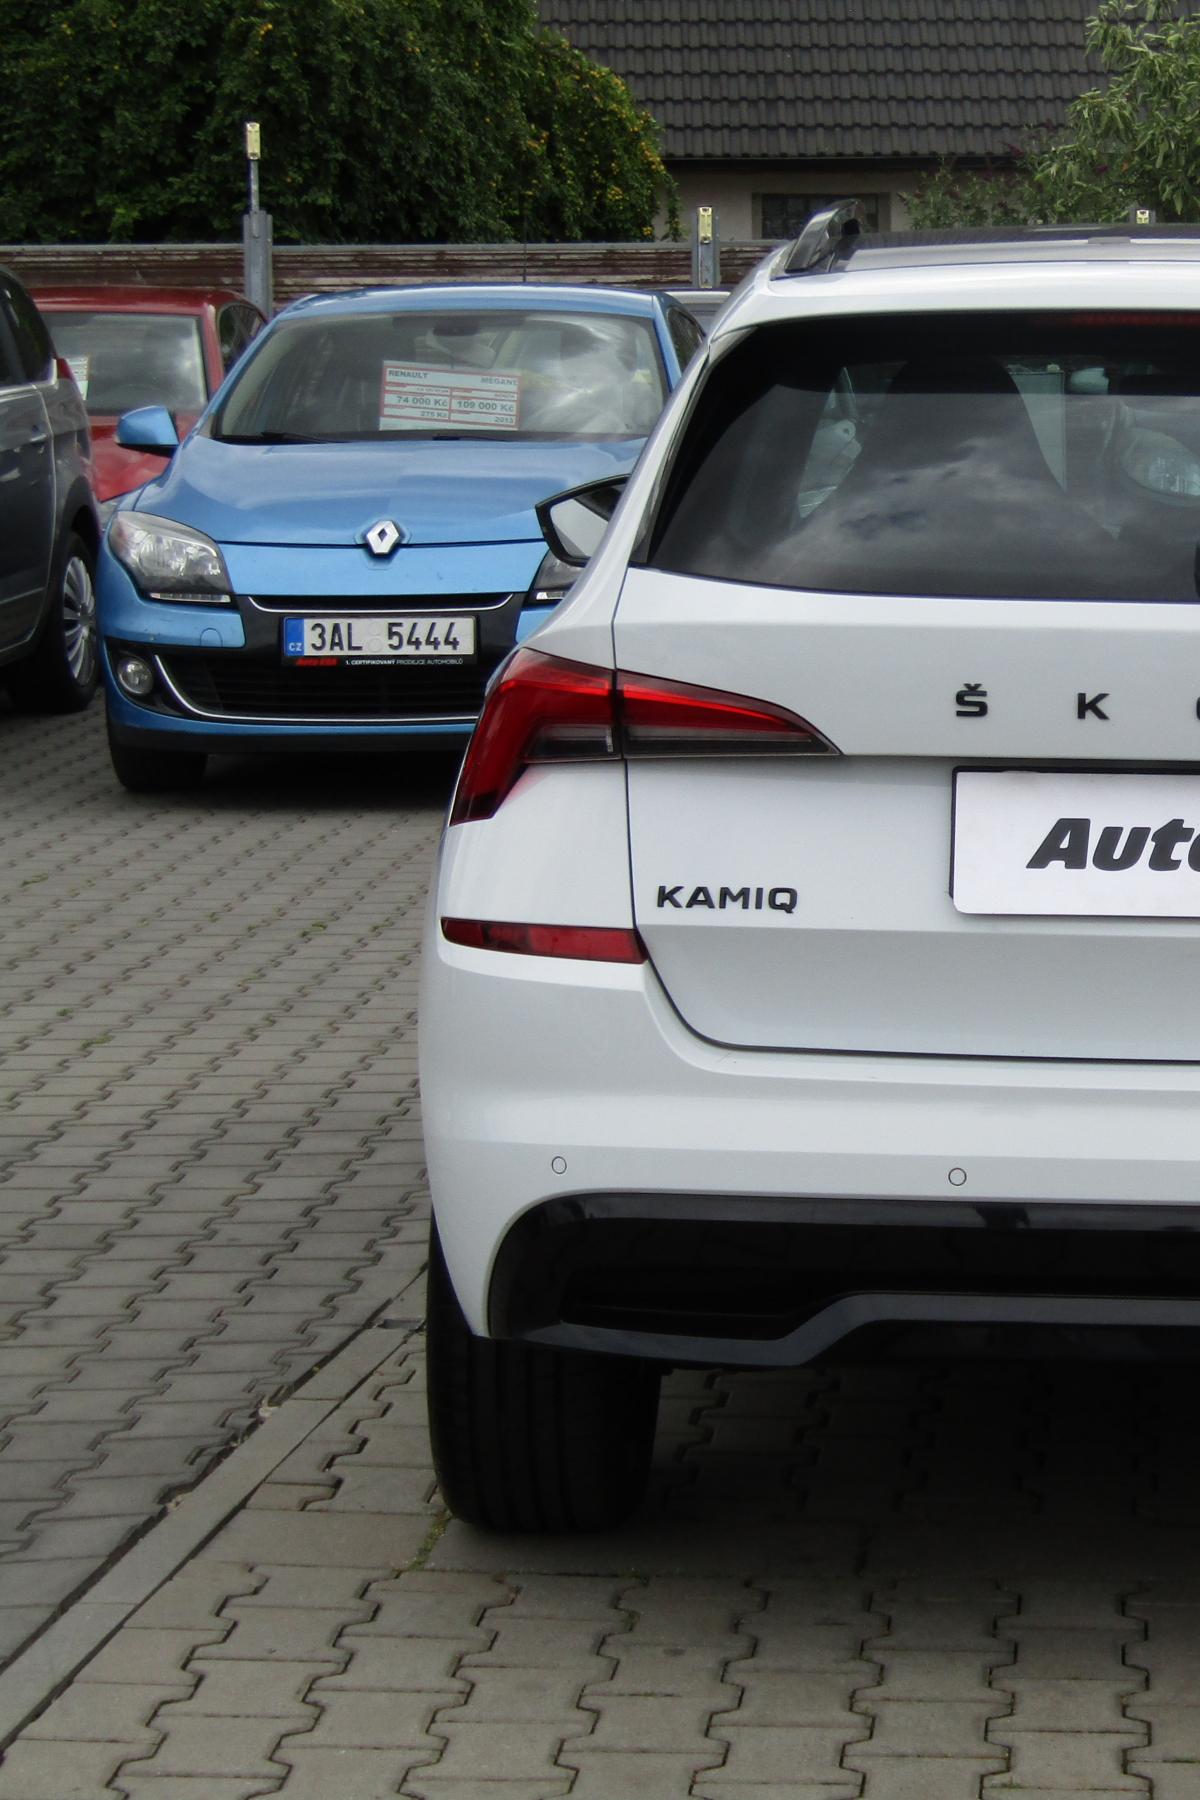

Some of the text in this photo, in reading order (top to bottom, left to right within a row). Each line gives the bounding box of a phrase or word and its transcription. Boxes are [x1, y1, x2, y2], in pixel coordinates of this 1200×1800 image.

[388, 369, 428, 379] RENAULT
[397, 395, 409, 403] 74
[411, 397, 432, 405] 000
[457, 400, 476, 408] 109
[478, 401, 497, 410] 000
[311, 622, 460, 651] 3AL 5444
[288, 642, 303, 651] CZ
[657, 885, 798, 914] KAMIQ
